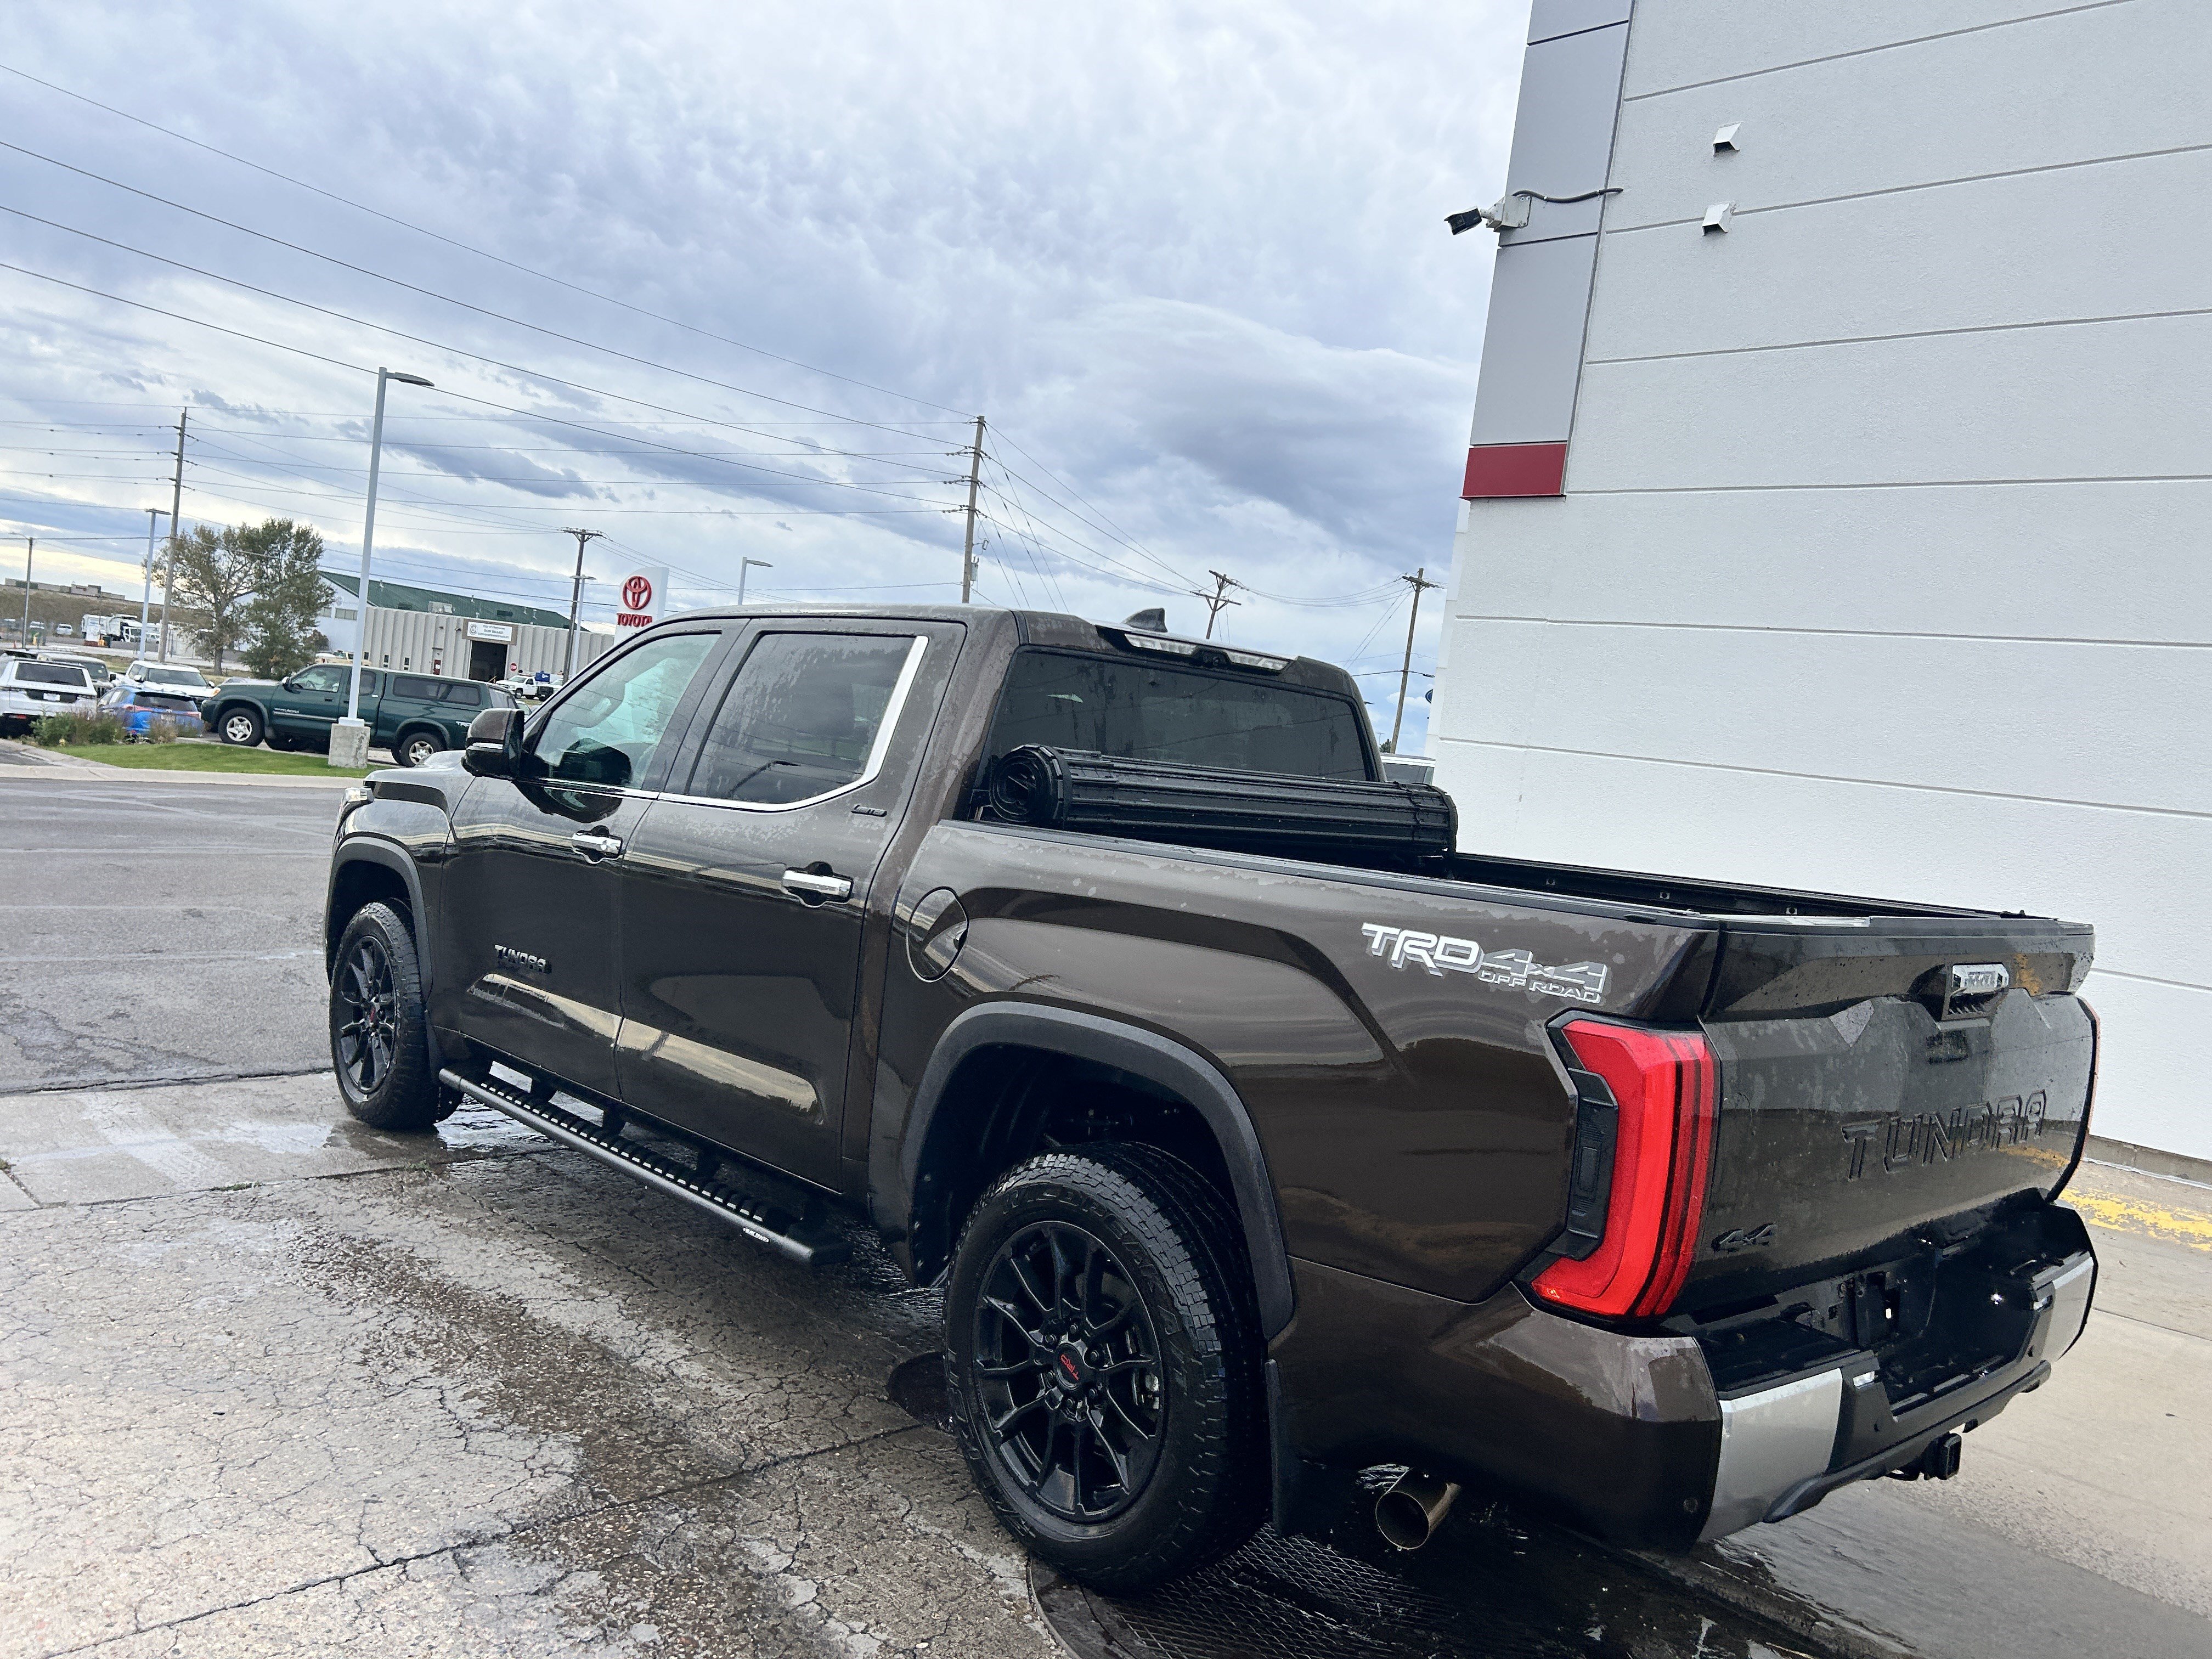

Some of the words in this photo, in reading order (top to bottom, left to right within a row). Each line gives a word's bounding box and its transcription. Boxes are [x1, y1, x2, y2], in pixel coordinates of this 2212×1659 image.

[617, 613, 652, 627] TOYOTA
[494, 944, 548, 973] TUNDRA
[1362, 922, 1485, 977] TRD
[1481, 947, 1608, 992] 4x4
[1478, 970, 1527, 988] OFF
[1528, 981, 1601, 1005] ROAD
[1841, 1089, 2047, 1182] TUNDRA
